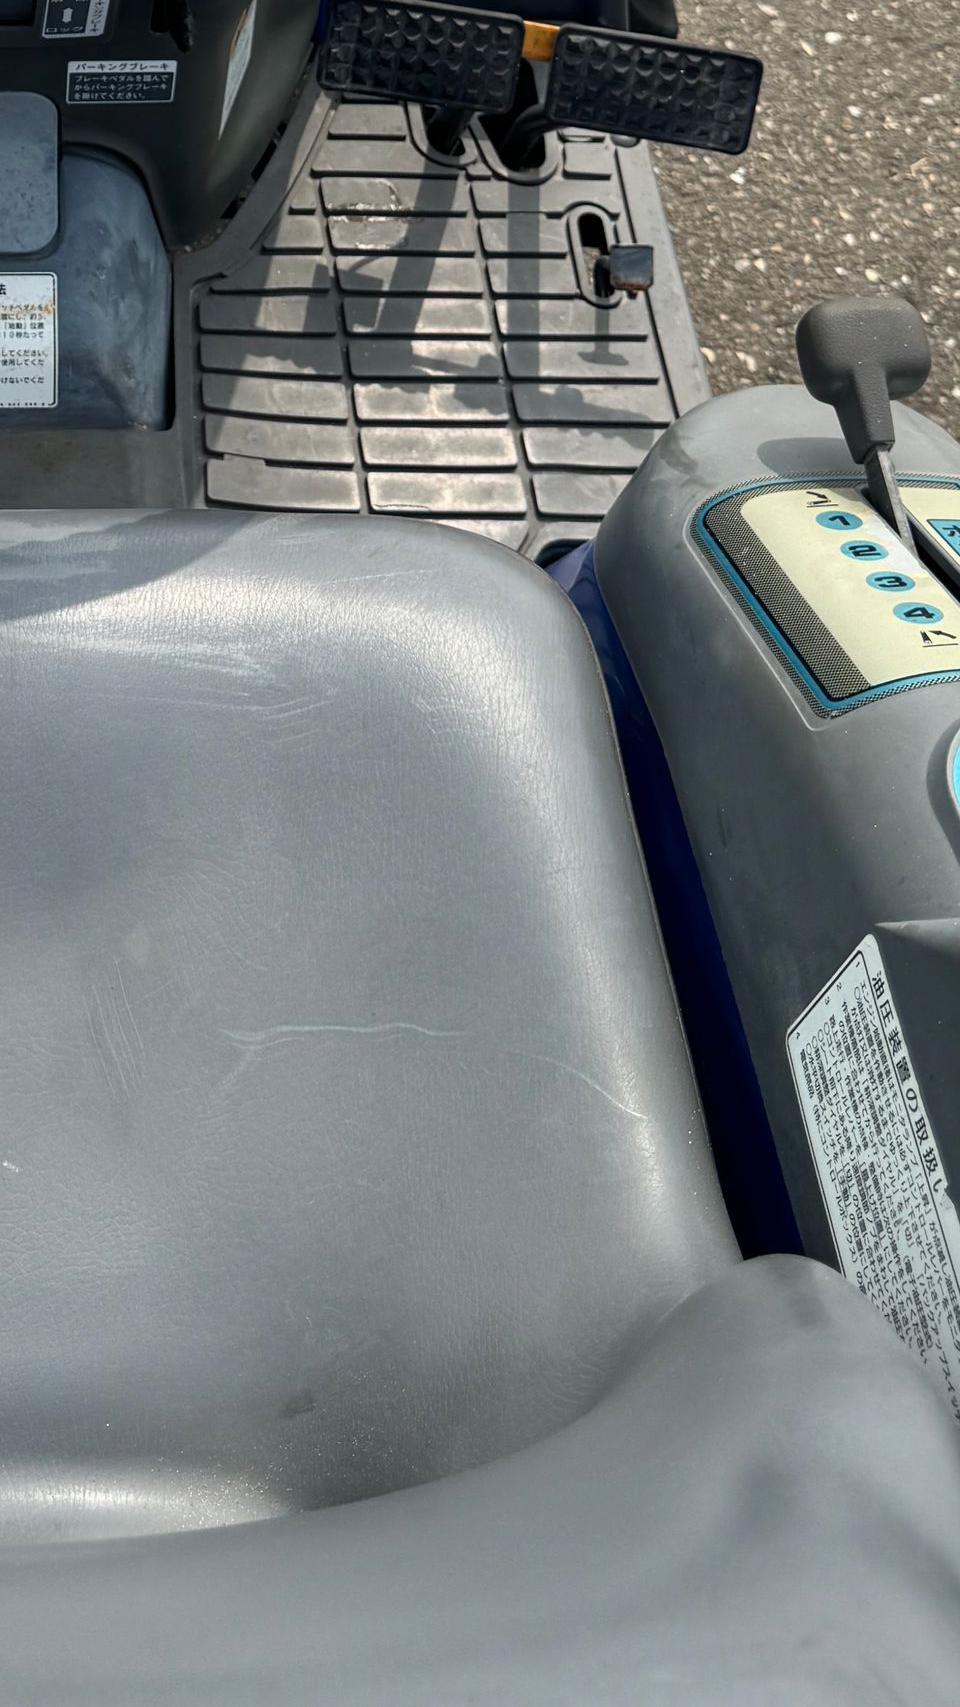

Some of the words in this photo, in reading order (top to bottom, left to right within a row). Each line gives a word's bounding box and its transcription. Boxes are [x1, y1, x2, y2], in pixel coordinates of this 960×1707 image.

[828, 515, 850, 526] 1
[848, 545, 881, 556] 2
[874, 576, 907, 588] 3
[904, 607, 935, 619] 4
